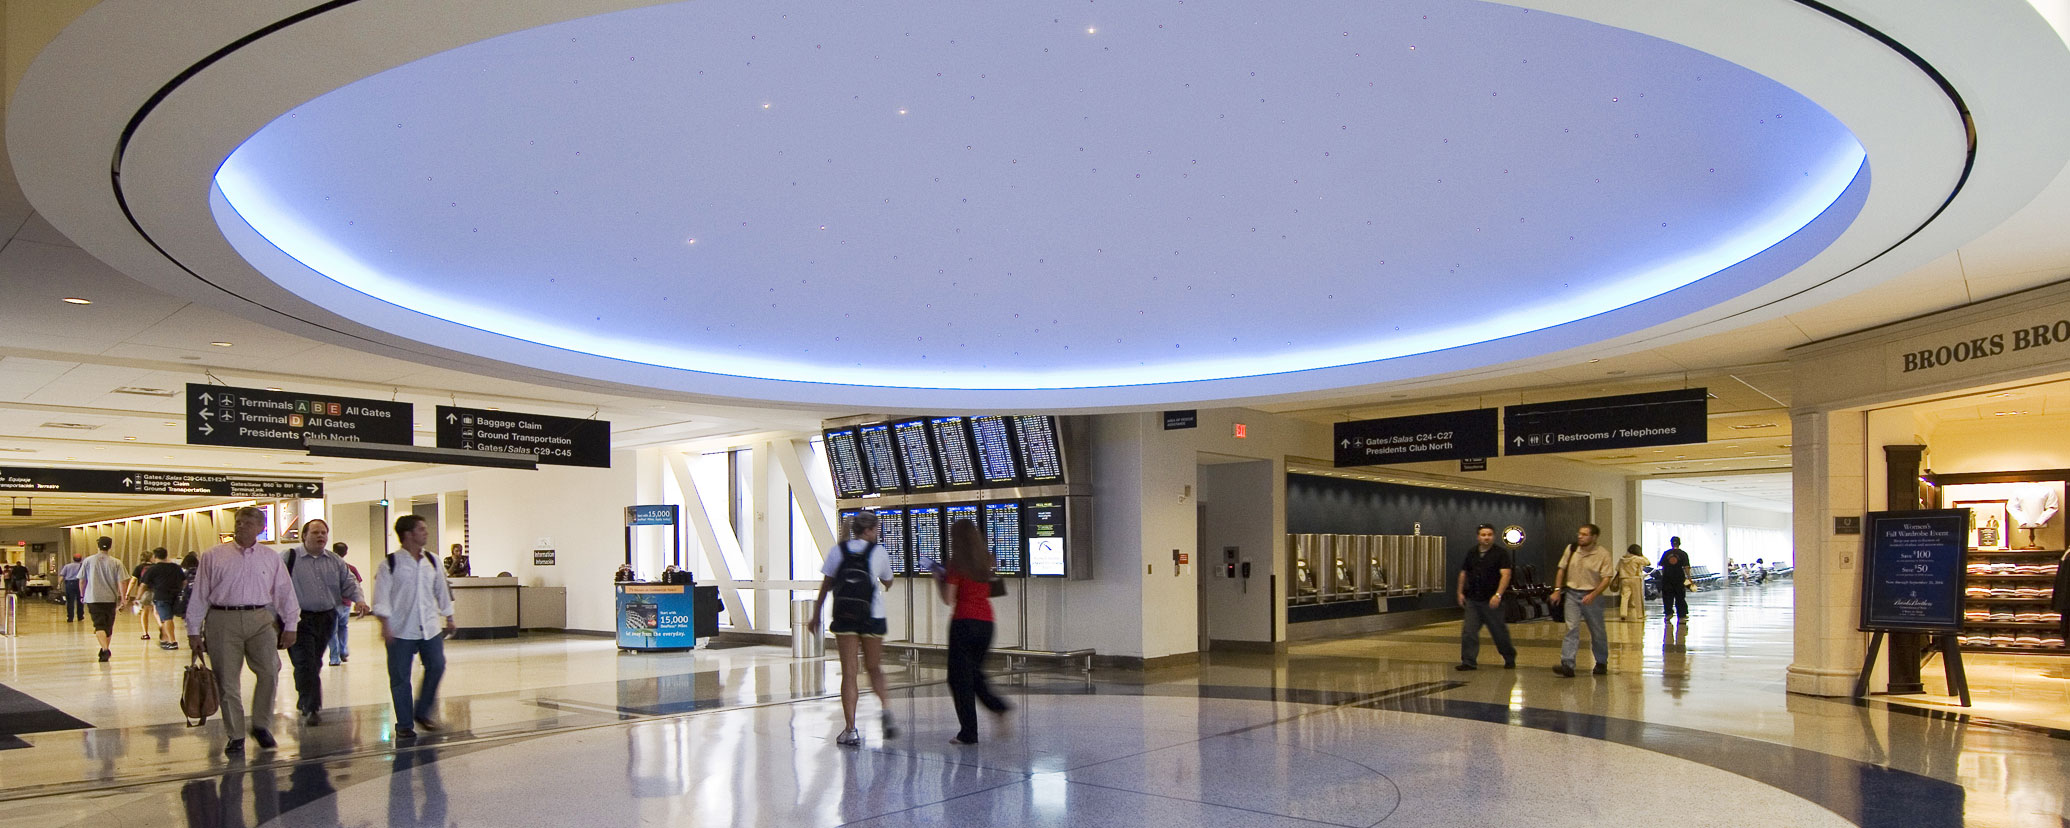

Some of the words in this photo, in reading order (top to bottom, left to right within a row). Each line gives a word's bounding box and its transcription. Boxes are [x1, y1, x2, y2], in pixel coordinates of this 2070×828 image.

[1902, 334, 2004, 372] BROOKS
[240, 397, 294, 411] Terminals
[346, 406, 361, 416] All
[362, 408, 392, 418] Gates
[240, 412, 288, 425] Terminal
[308, 417, 324, 427] All
[324, 418, 356, 430] Gates
[477, 417, 516, 429] Baggage
[518, 420, 542, 430] Claim
[240, 427, 300, 440] Presidents
[303, 431, 328, 441] Club
[330, 433, 360, 442] North
[477, 430, 509, 440] Ground
[512, 432, 572, 446] Transportation
[1366, 436, 1414, 446] Gates/Salas
[1416, 432, 1454, 442] C24-C27
[1558, 432, 1610, 442] Restrooms
[1619, 426, 1677, 438] Telephones
[477, 443, 531, 455] Gates/Salas
[534, 446, 572, 457] C29-C45
[1366, 445, 1407, 456] Presidents
[1409, 443, 1428, 452] Club
[1429, 441, 1453, 450] North
[660, 616, 688, 624] 15,000
